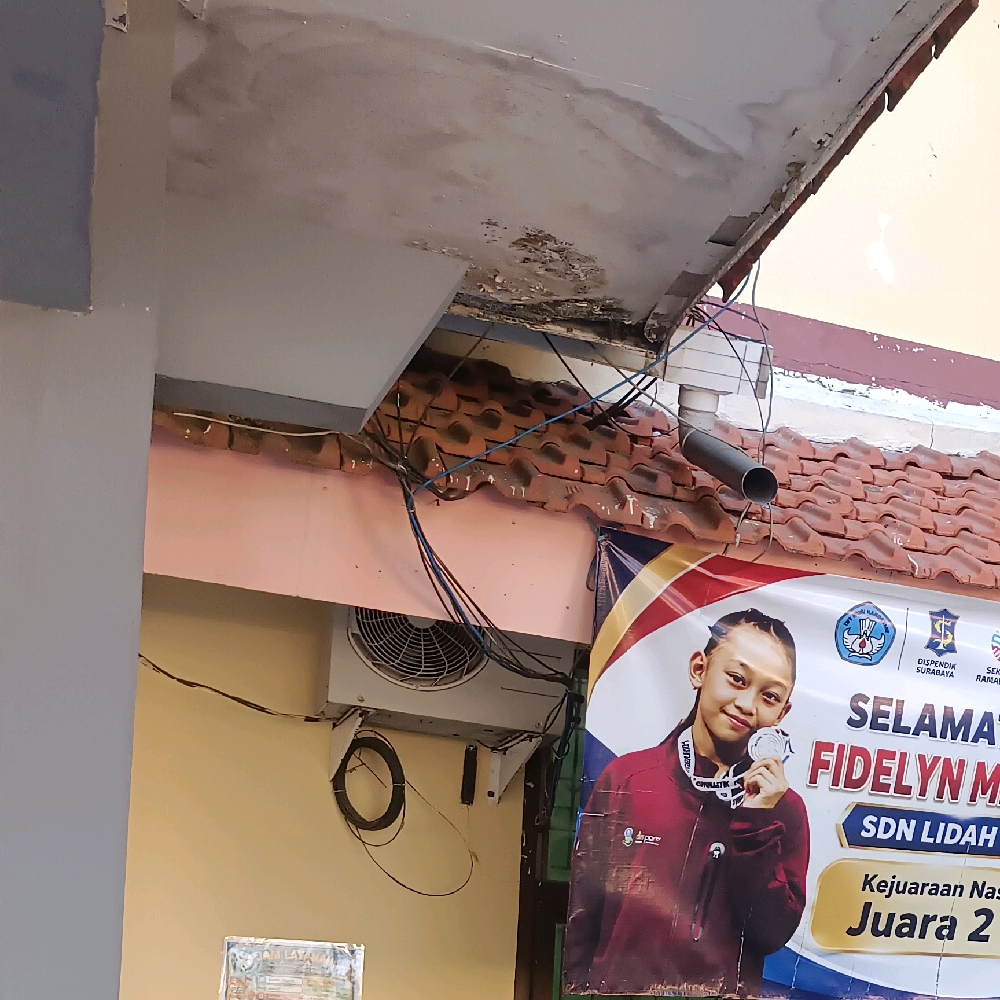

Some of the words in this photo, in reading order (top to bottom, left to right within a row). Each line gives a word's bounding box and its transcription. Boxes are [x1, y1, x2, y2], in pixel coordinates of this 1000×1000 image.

[915, 666, 955, 679] SURABAYA
[917, 658, 957, 671] DISPENDIK
[807, 741, 966, 803] FIDELYN
[861, 814, 918, 842] SDN
[920, 820, 997, 849] LIDAH
[861, 873, 964, 899] Kejuaraan
[846, 901, 958, 942] Juara
[968, 907, 995, 943] 2
